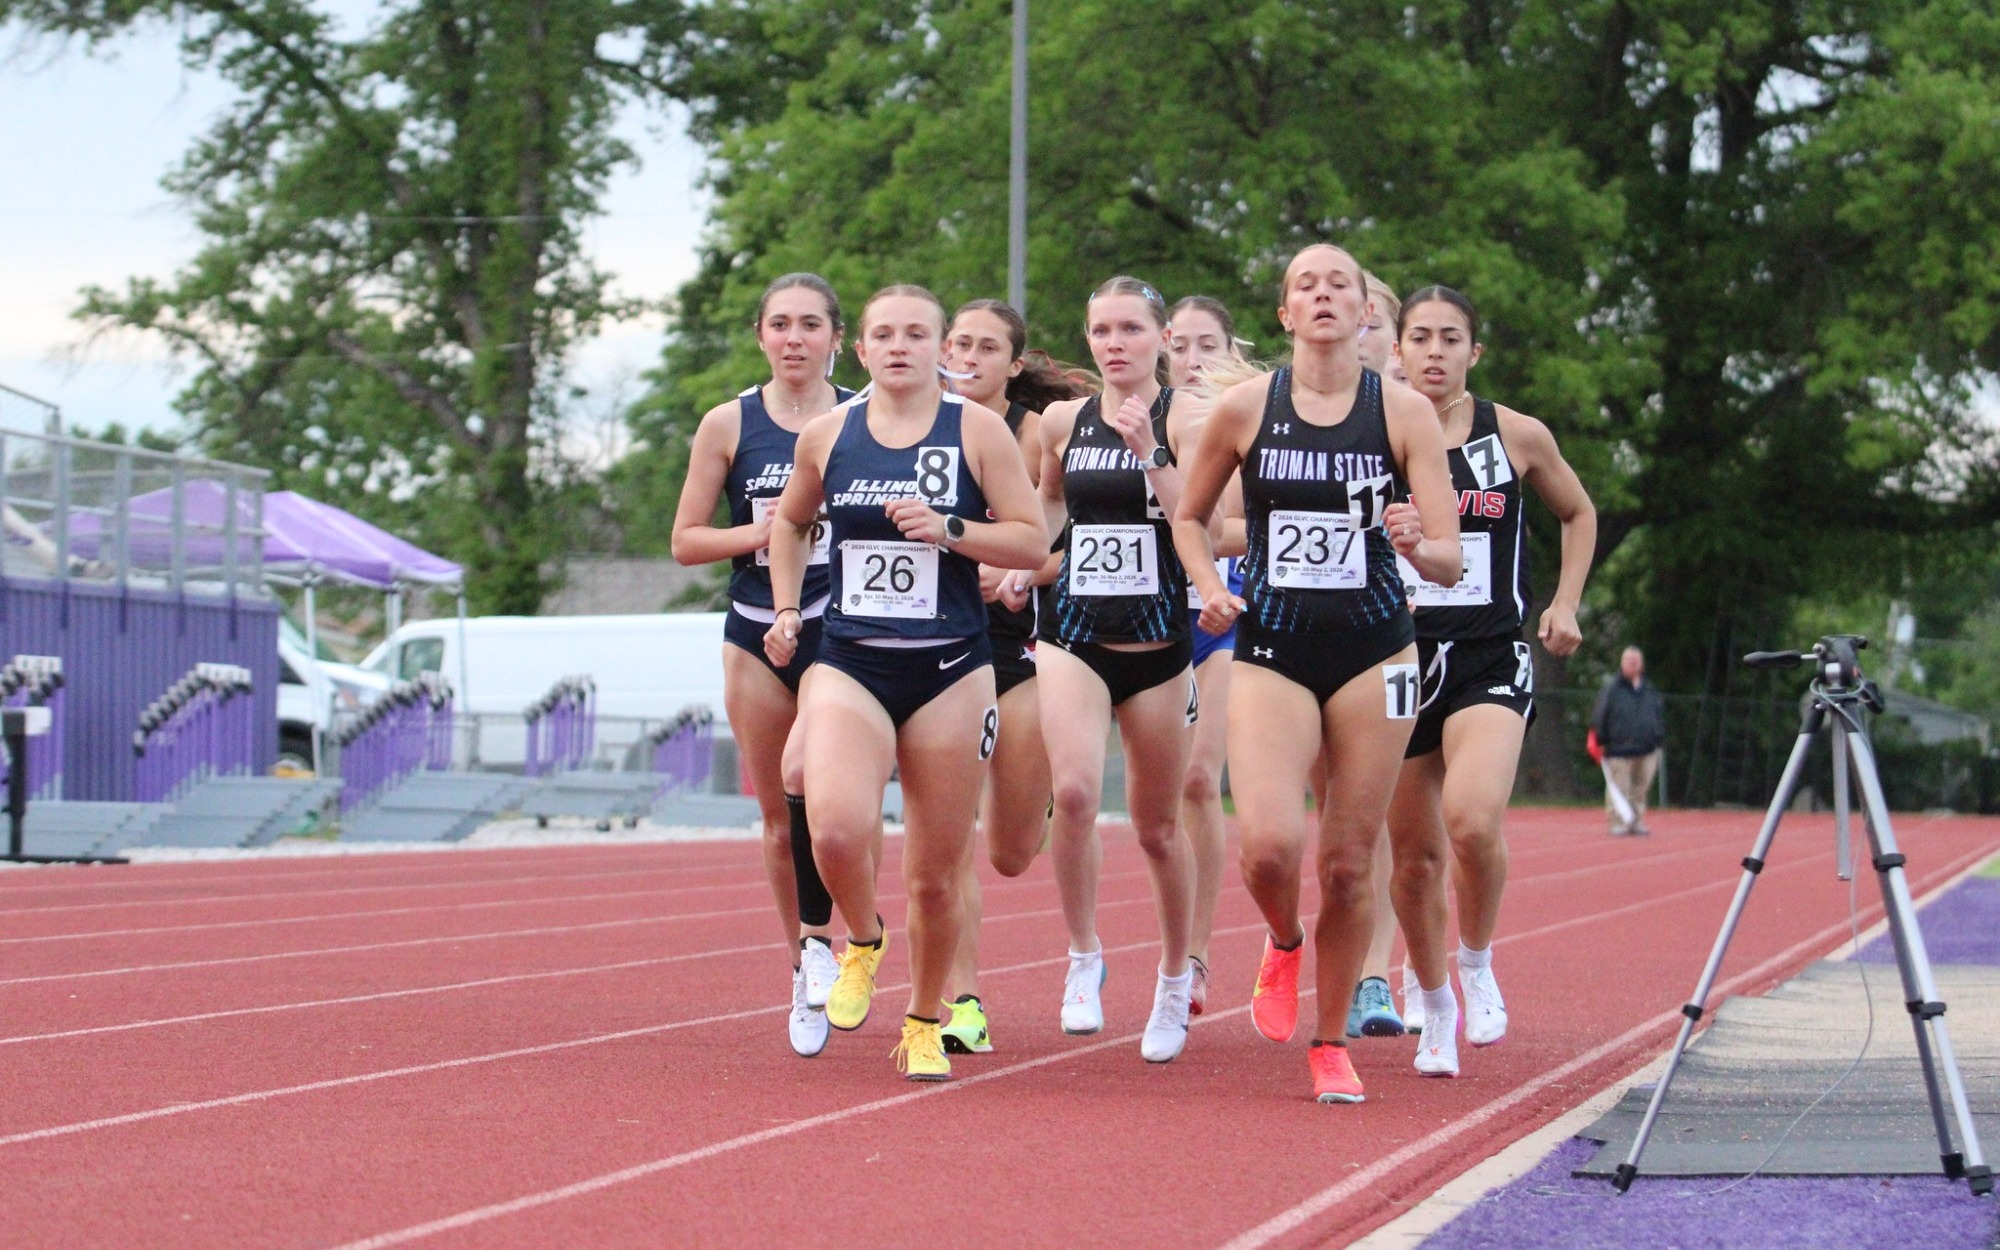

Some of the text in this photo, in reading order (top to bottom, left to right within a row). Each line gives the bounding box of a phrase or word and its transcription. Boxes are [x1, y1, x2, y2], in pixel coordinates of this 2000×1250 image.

[918, 449, 950, 498] 8
[1065, 446, 1120, 474] TRUMAN
[1259, 448, 1327, 481] TRUMAN
[1467, 437, 1499, 487] 7
[847, 479, 917, 493] ILLINO
[881, 545, 931, 553] CHAMPIONSHIPS
[1077, 537, 1142, 573] 231
[1276, 524, 1356, 565] 237
[863, 554, 914, 594] 26
[980, 708, 997, 759] 8
